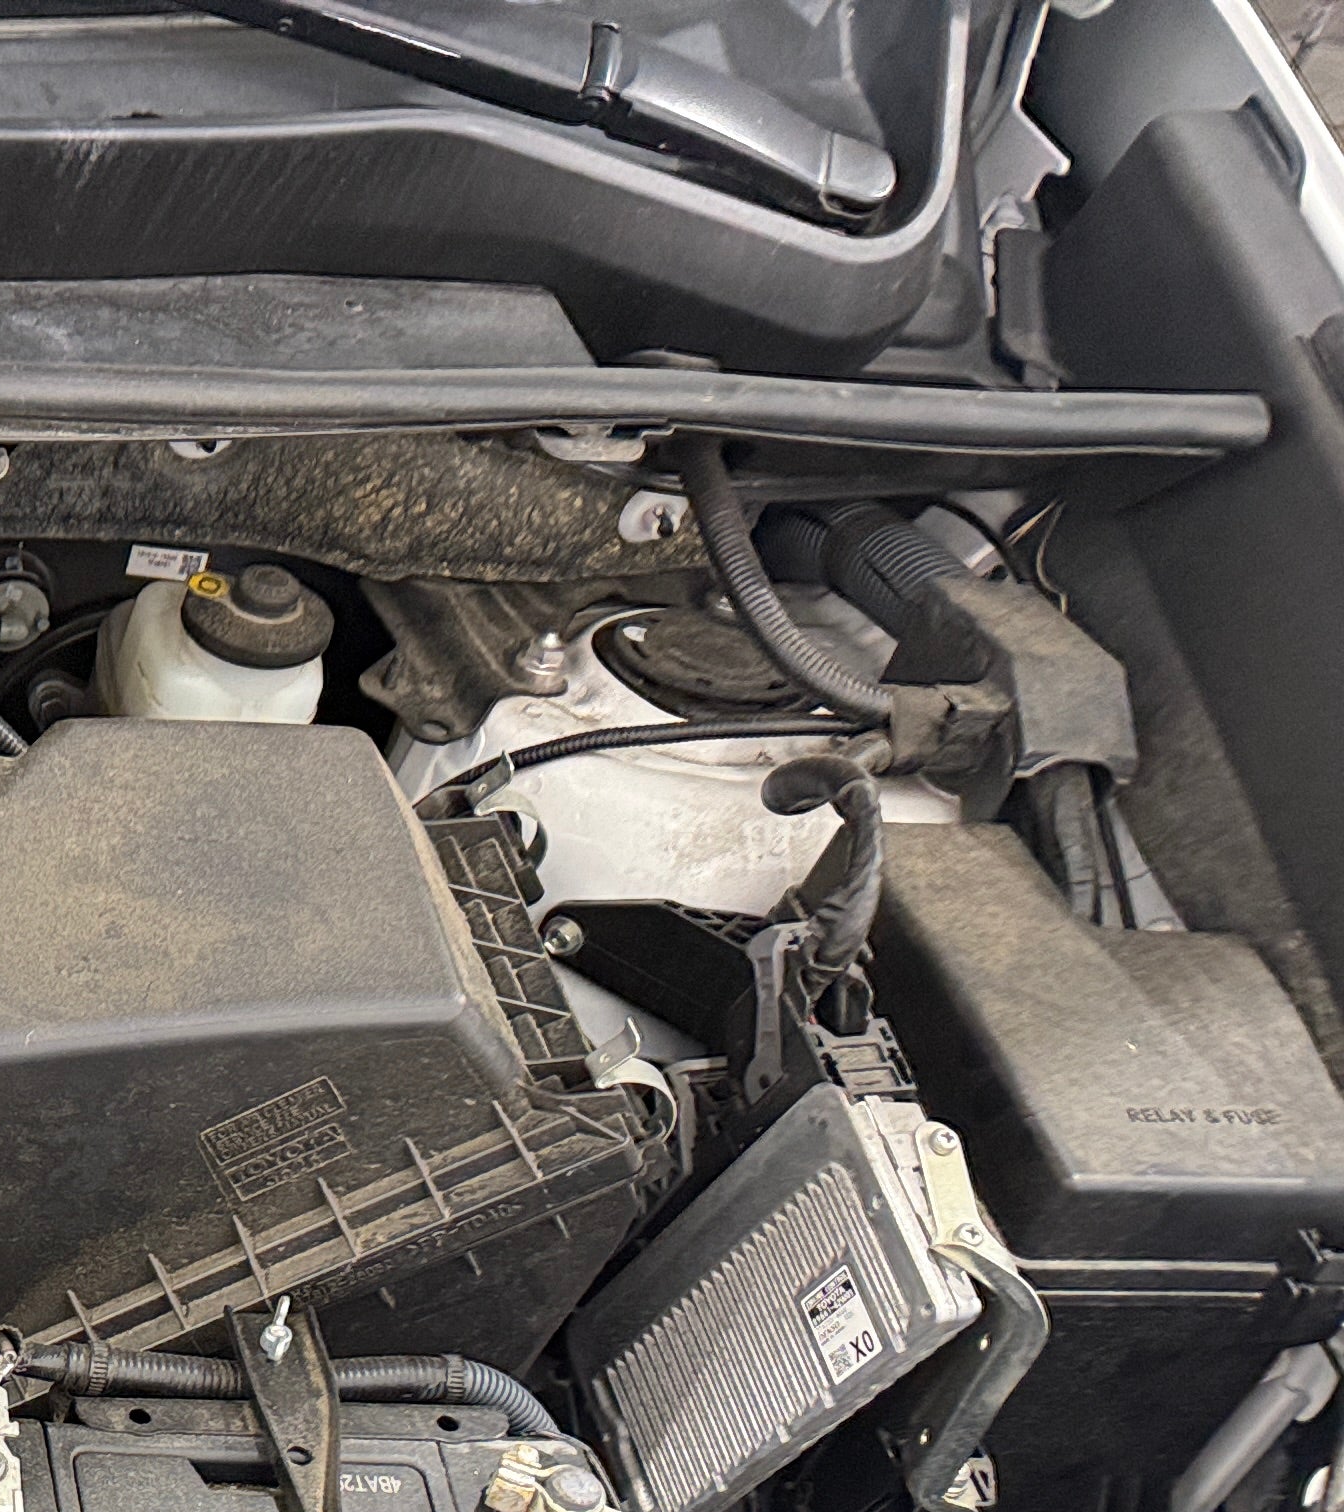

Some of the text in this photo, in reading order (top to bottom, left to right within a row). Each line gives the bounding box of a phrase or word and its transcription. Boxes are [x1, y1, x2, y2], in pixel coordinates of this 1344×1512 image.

[1126, 1106, 1281, 1126] RELAY & FUSE
[817, 1284, 846, 1314] TOYOTA
